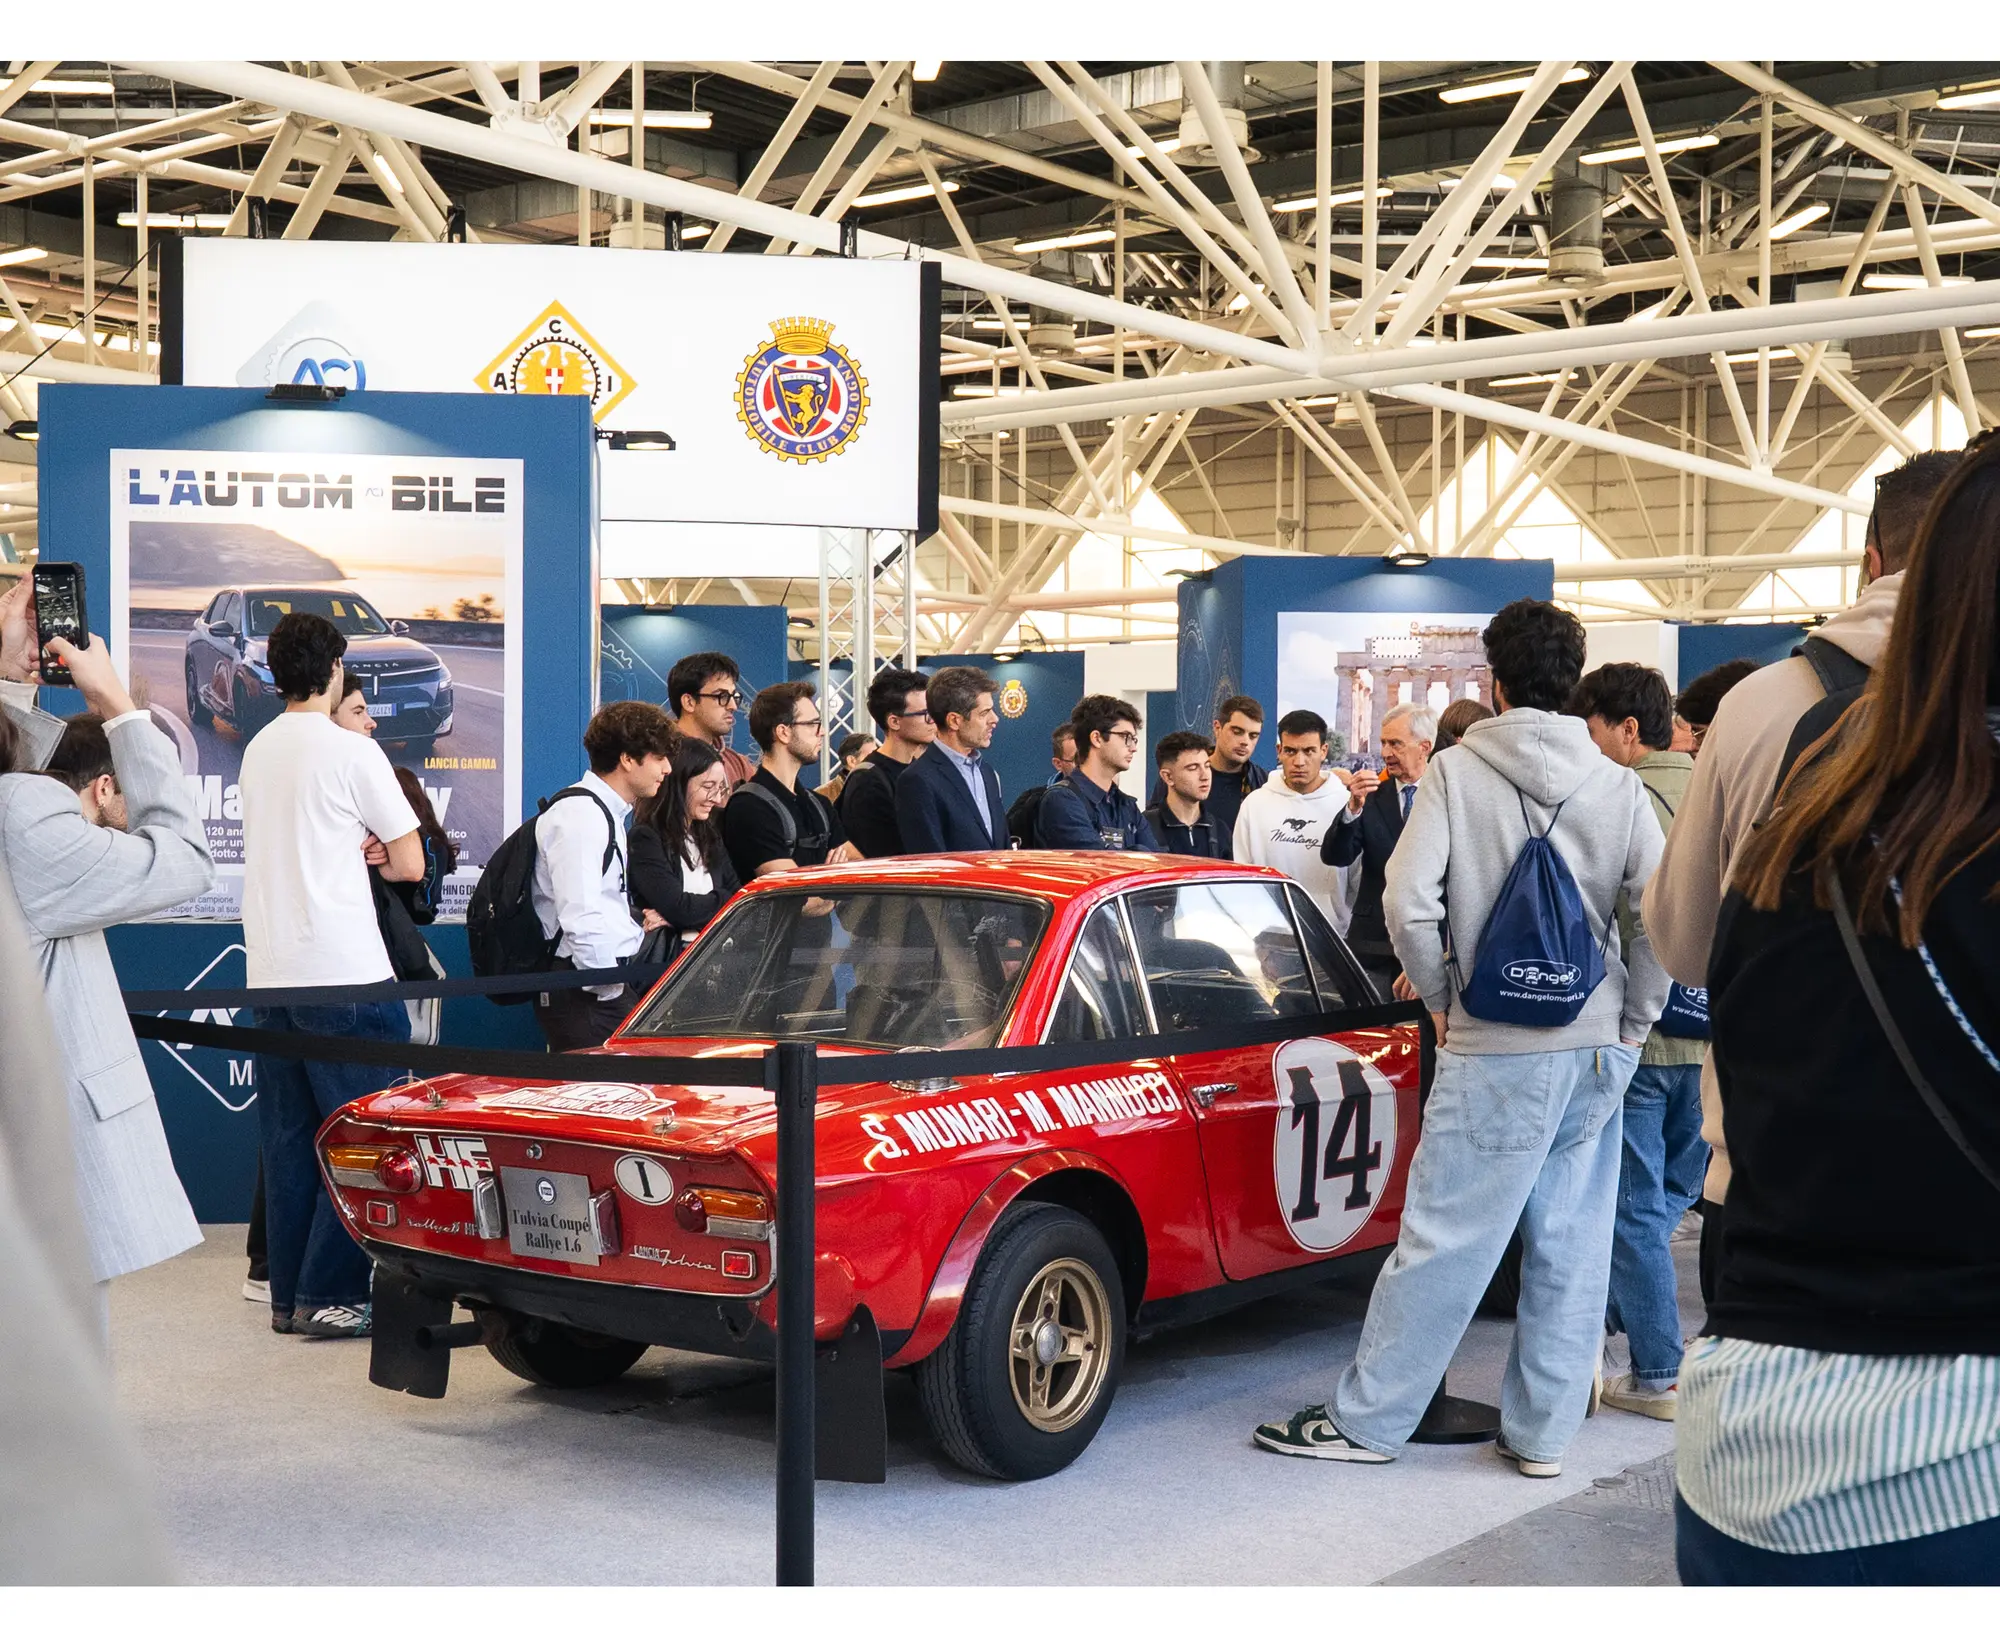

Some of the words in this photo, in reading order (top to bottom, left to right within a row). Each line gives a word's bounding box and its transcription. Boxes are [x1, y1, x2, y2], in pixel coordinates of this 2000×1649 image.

[745, 356, 788, 450] AUTOMOBILE
[796, 434, 839, 454] CLUB
[840, 359, 860, 434] BOLOGNA
[424, 757, 459, 769] LANCIA
[460, 757, 497, 770] GAMMA
[206, 826, 224, 836] 120
[1271, 829, 1322, 850] Mustang
[210, 839, 228, 848] per
[195, 904, 215, 913] Salita
[860, 1112, 909, 1159] S.
[894, 1098, 1017, 1153] MUNARI
[1014, 1090, 1063, 1133] M.
[1286, 1058, 1382, 1224] 14
[414, 1134, 494, 1191] HF
[525, 1231, 562, 1254] Rallye
[564, 1237, 582, 1253] 1.6
